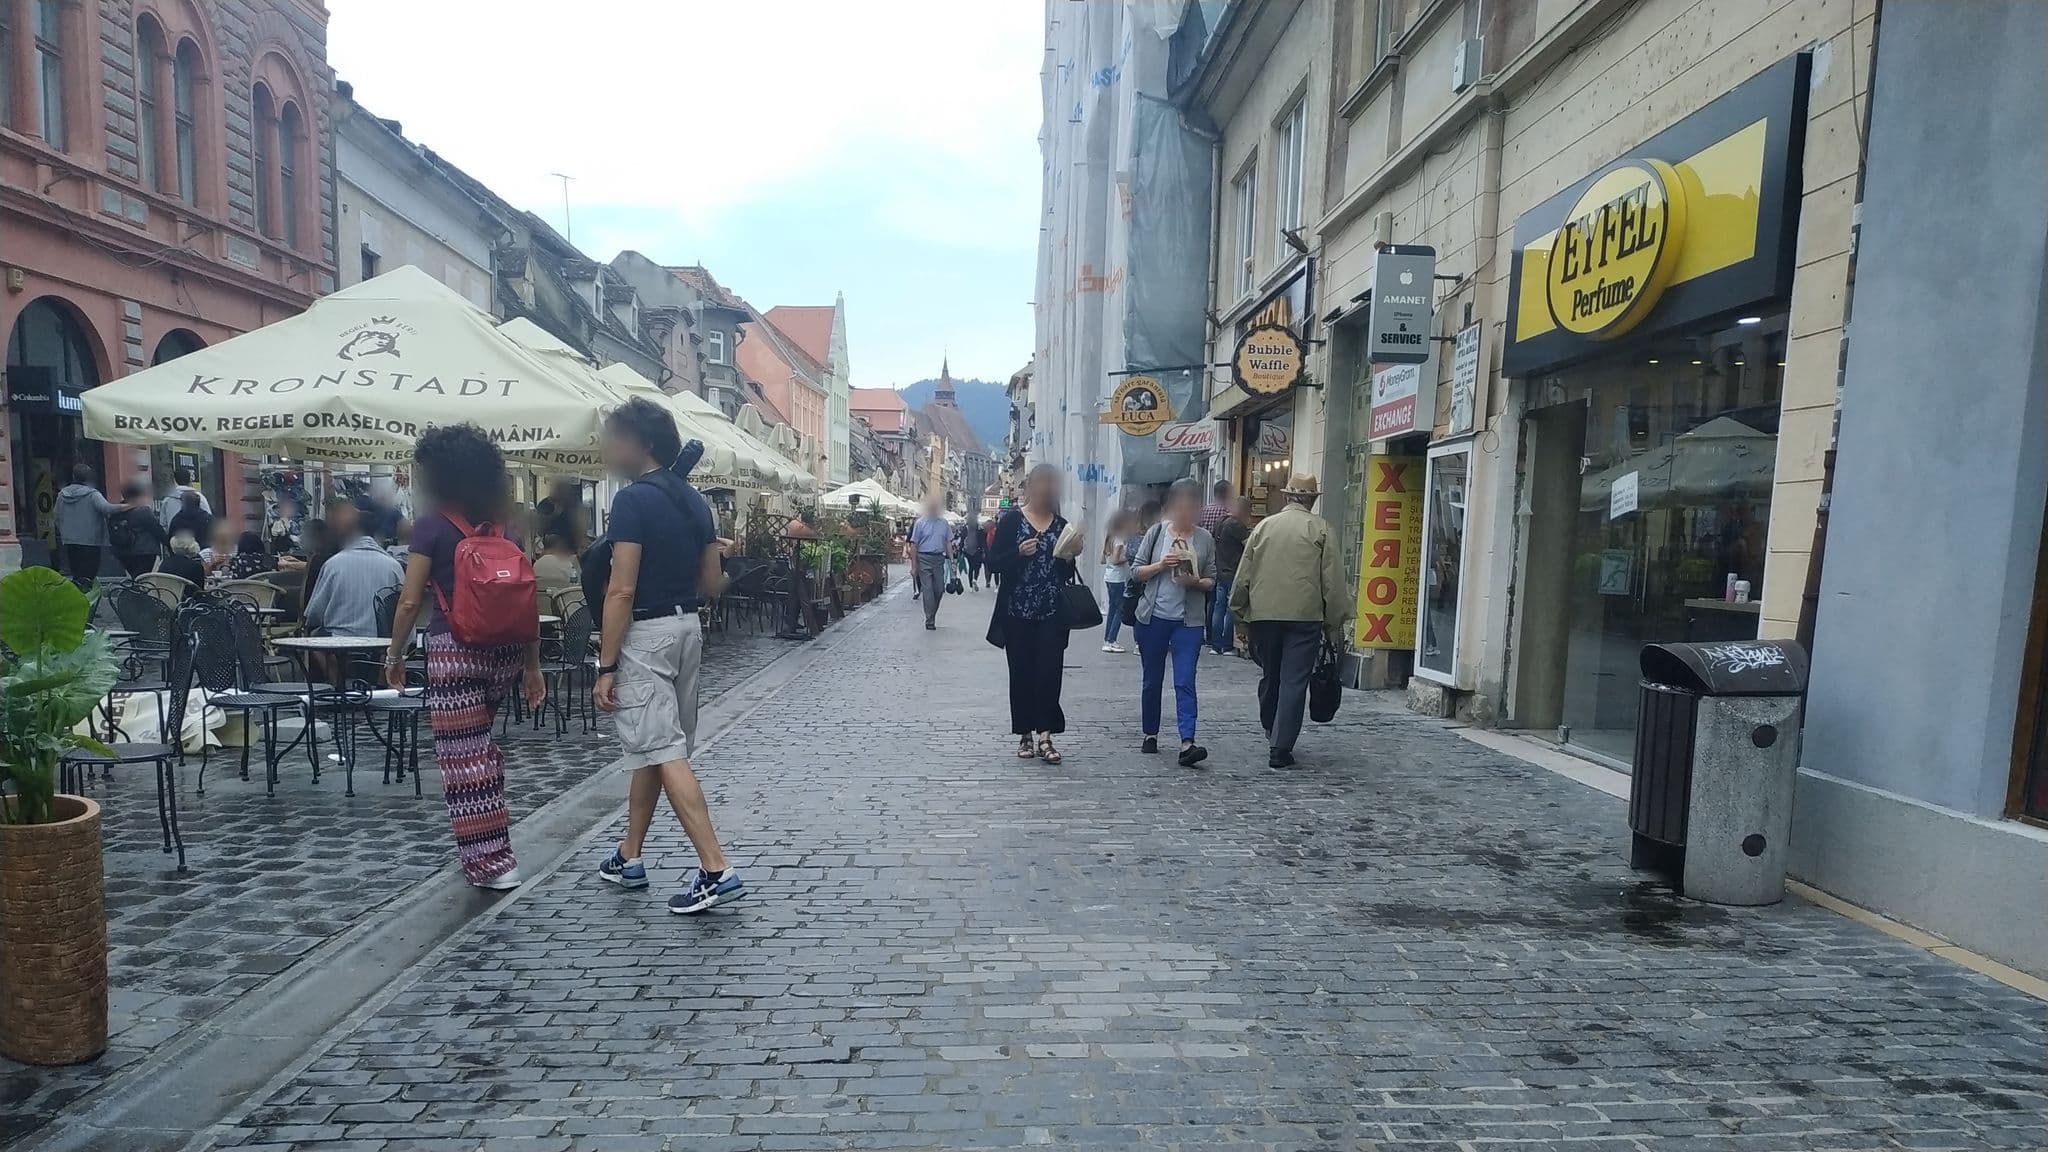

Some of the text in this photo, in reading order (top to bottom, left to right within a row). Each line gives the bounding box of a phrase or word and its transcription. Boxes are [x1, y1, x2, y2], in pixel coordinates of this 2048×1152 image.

[1560, 180, 1658, 285] EYFEL
[1383, 295, 1426, 305] AMANET
[1570, 275, 1635, 322] Perfume
[1399, 323, 1407, 332] &
[1380, 333, 1422, 345] SERVICE
[1247, 344, 1293, 356] Bubble
[1248, 359, 1291, 371] Waffle
[1252, 372, 1285, 381] Boutique
[187, 368, 520, 399] KRONSTADT
[1121, 412, 1156, 422] LUCA
[1374, 404, 1413, 433] EXCHANGE
[216, 413, 295, 432] REGELE
[302, 412, 418, 438] ORAȘELOR
